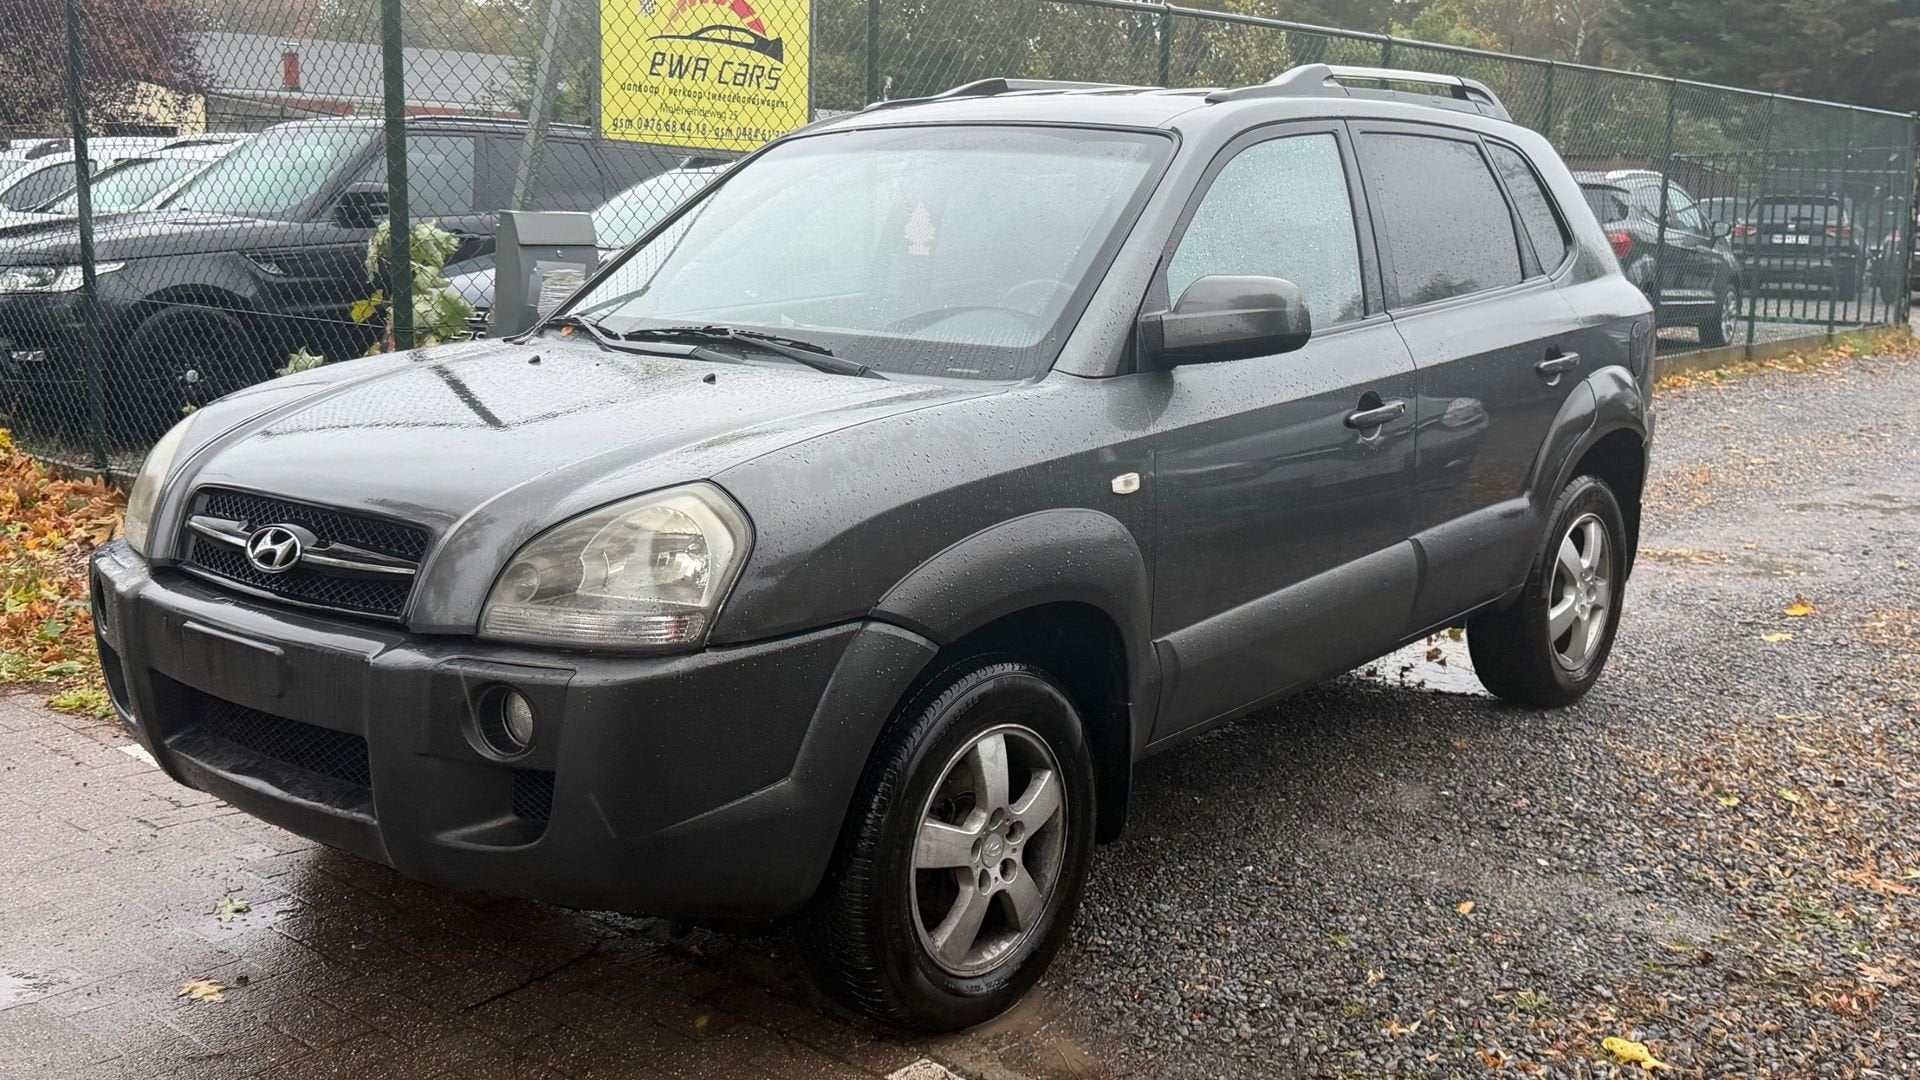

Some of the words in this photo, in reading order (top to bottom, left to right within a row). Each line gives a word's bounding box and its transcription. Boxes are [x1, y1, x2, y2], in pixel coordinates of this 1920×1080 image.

[621, 81, 660, 95] aankoop
[669, 89, 704, 100] verkoop
[612, 117, 633, 131] gsm
[637, 117, 662, 132] 0476
[664, 120, 677, 133] 68
[696, 123, 707, 136] 18
